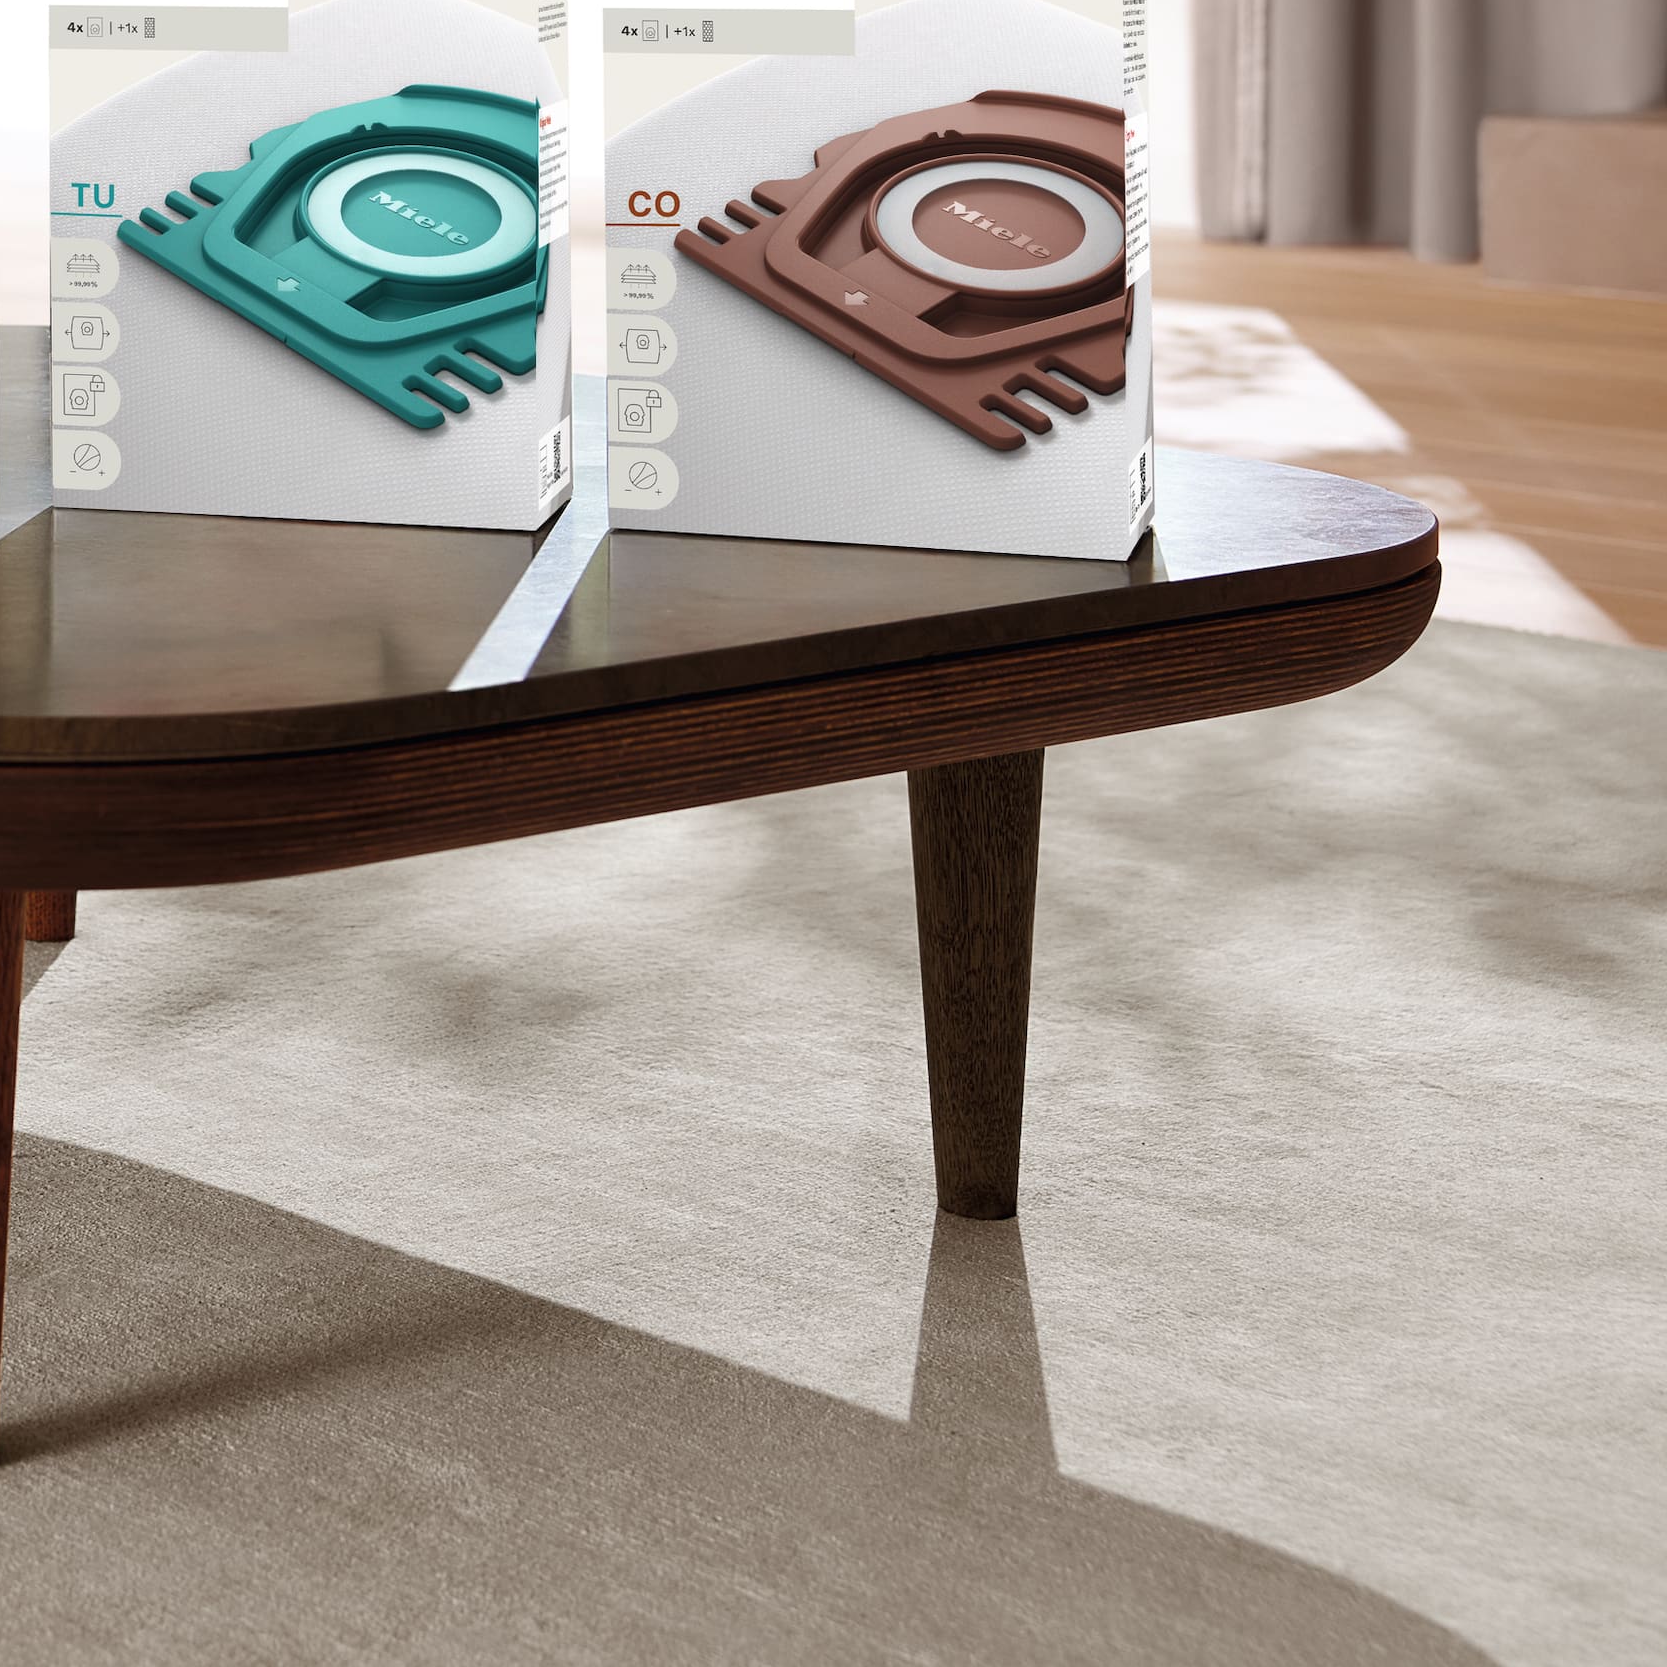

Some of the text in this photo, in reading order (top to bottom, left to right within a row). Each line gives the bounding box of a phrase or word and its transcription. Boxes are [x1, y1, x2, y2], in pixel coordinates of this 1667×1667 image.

[66, 21, 138, 34] 4x +1x
[620, 25, 696, 37] 4x +1x
[70, 182, 115, 209] TU
[627, 190, 681, 218] CO
[368, 191, 470, 247] Miele
[941, 200, 1051, 260] Miele
